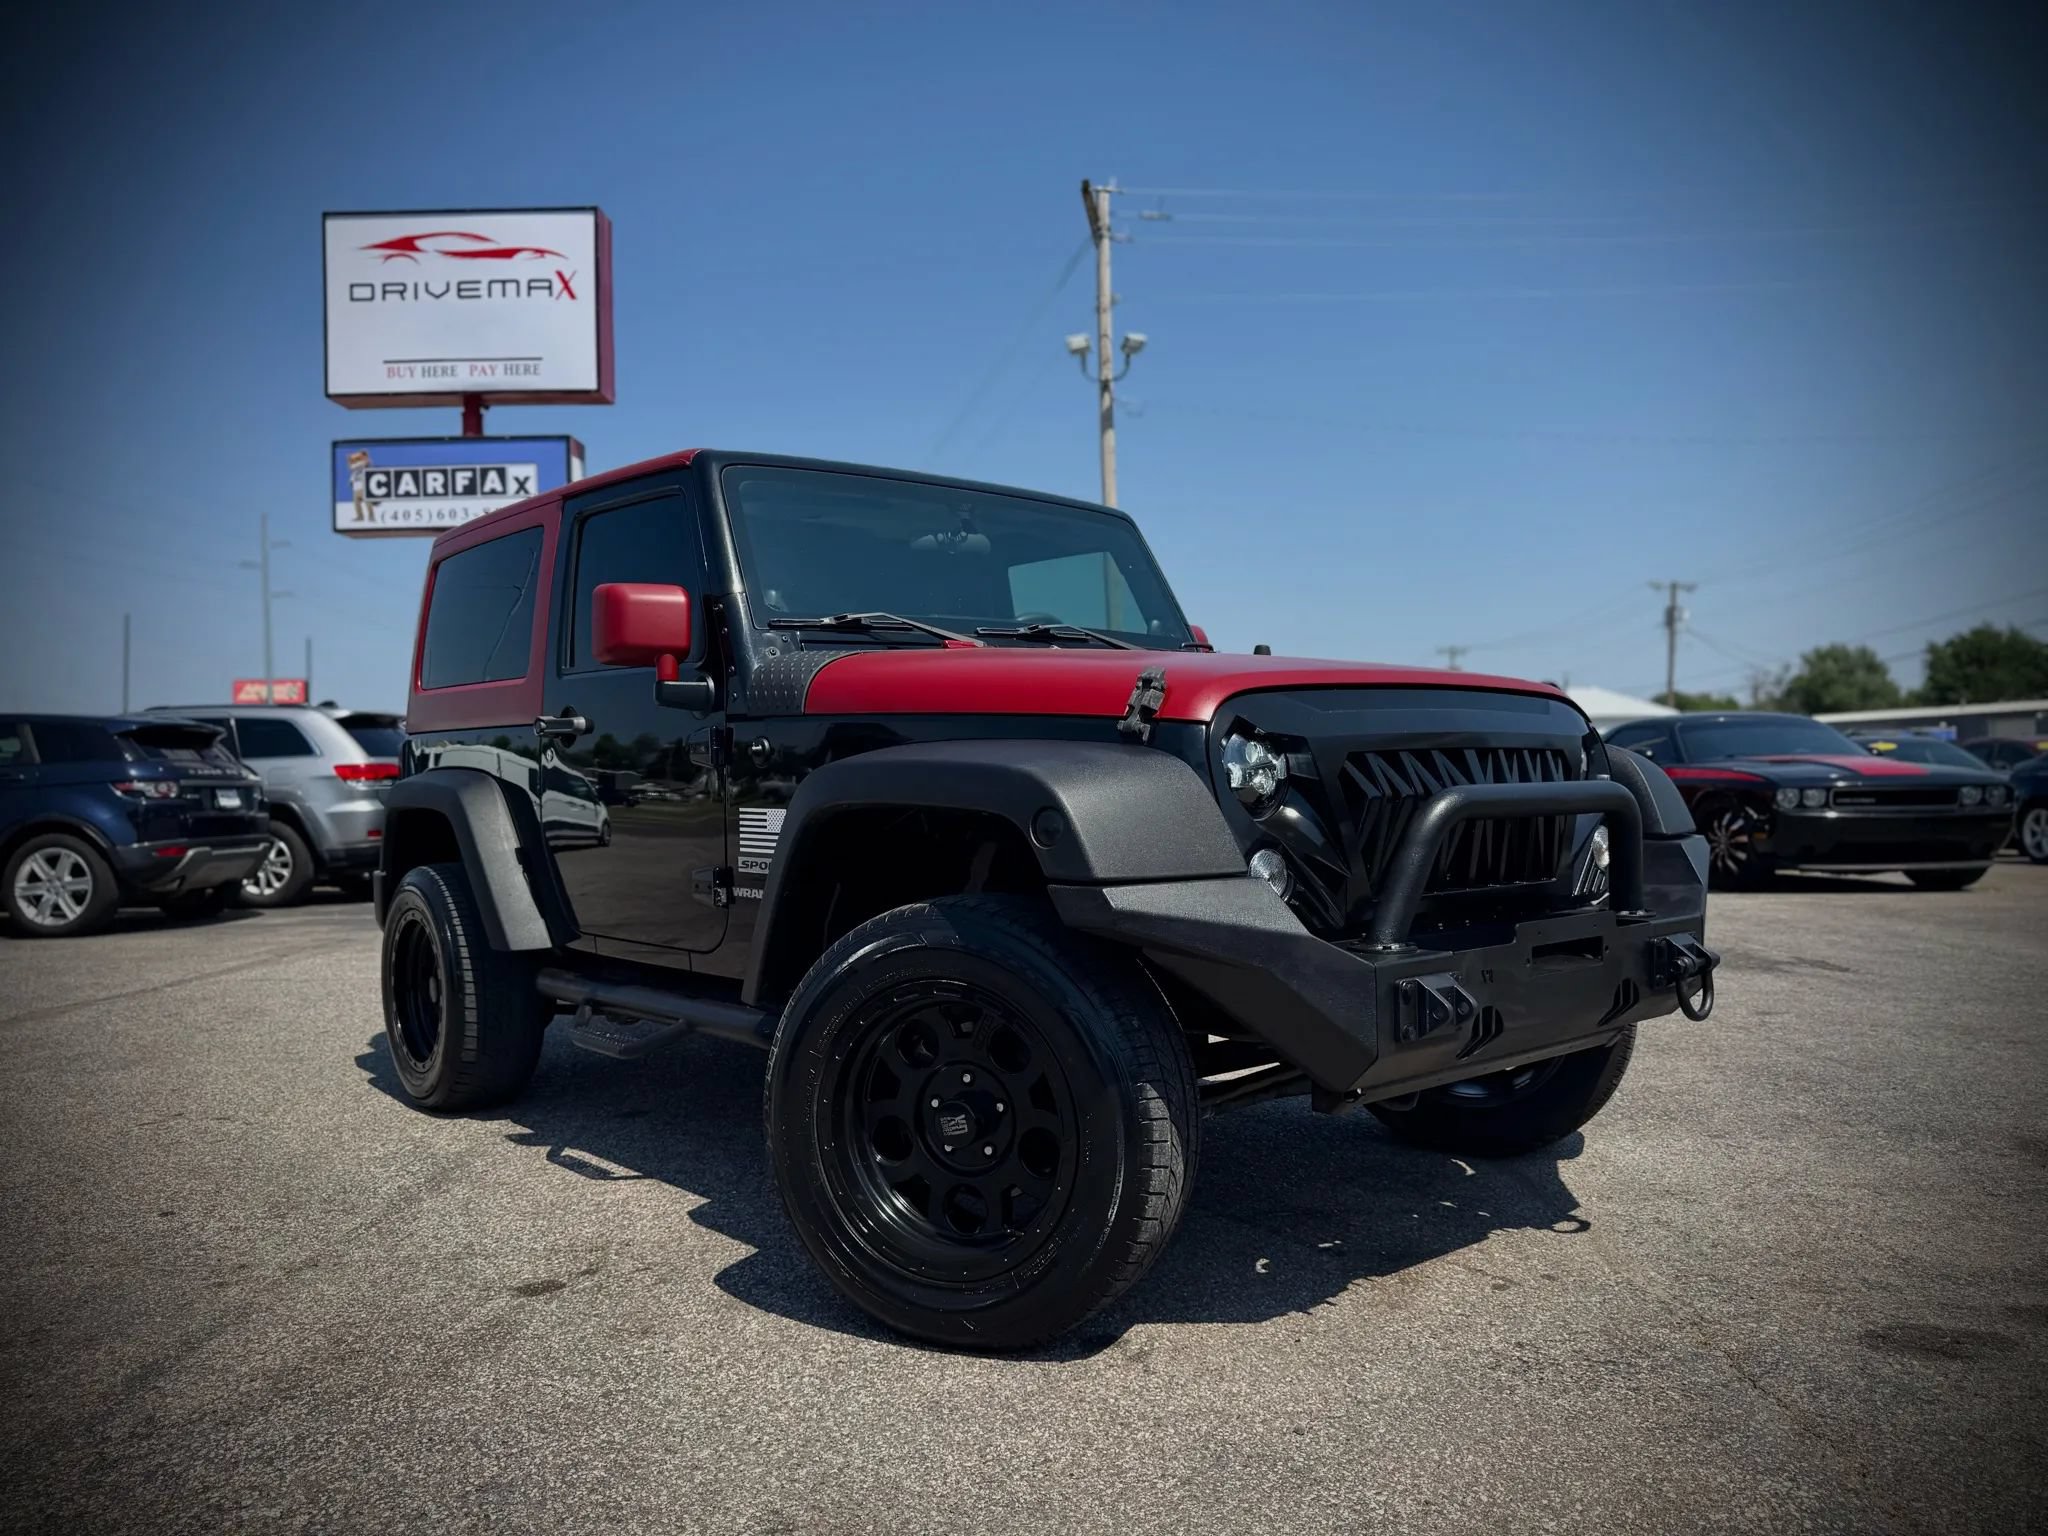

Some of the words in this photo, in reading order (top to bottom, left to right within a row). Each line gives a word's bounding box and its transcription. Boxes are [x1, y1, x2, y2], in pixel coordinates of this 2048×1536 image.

[349, 270, 578, 302] DRIVEMAX
[386, 365, 417, 379] BUY
[421, 365, 459, 379] HERE
[469, 364, 498, 378] PAY
[503, 363, 541, 377] HERE
[367, 469, 531, 497] CARFAX
[380, 507, 500, 524] (405)603-
[739, 859, 770, 871] SPO
[732, 886, 764, 899] WRA
